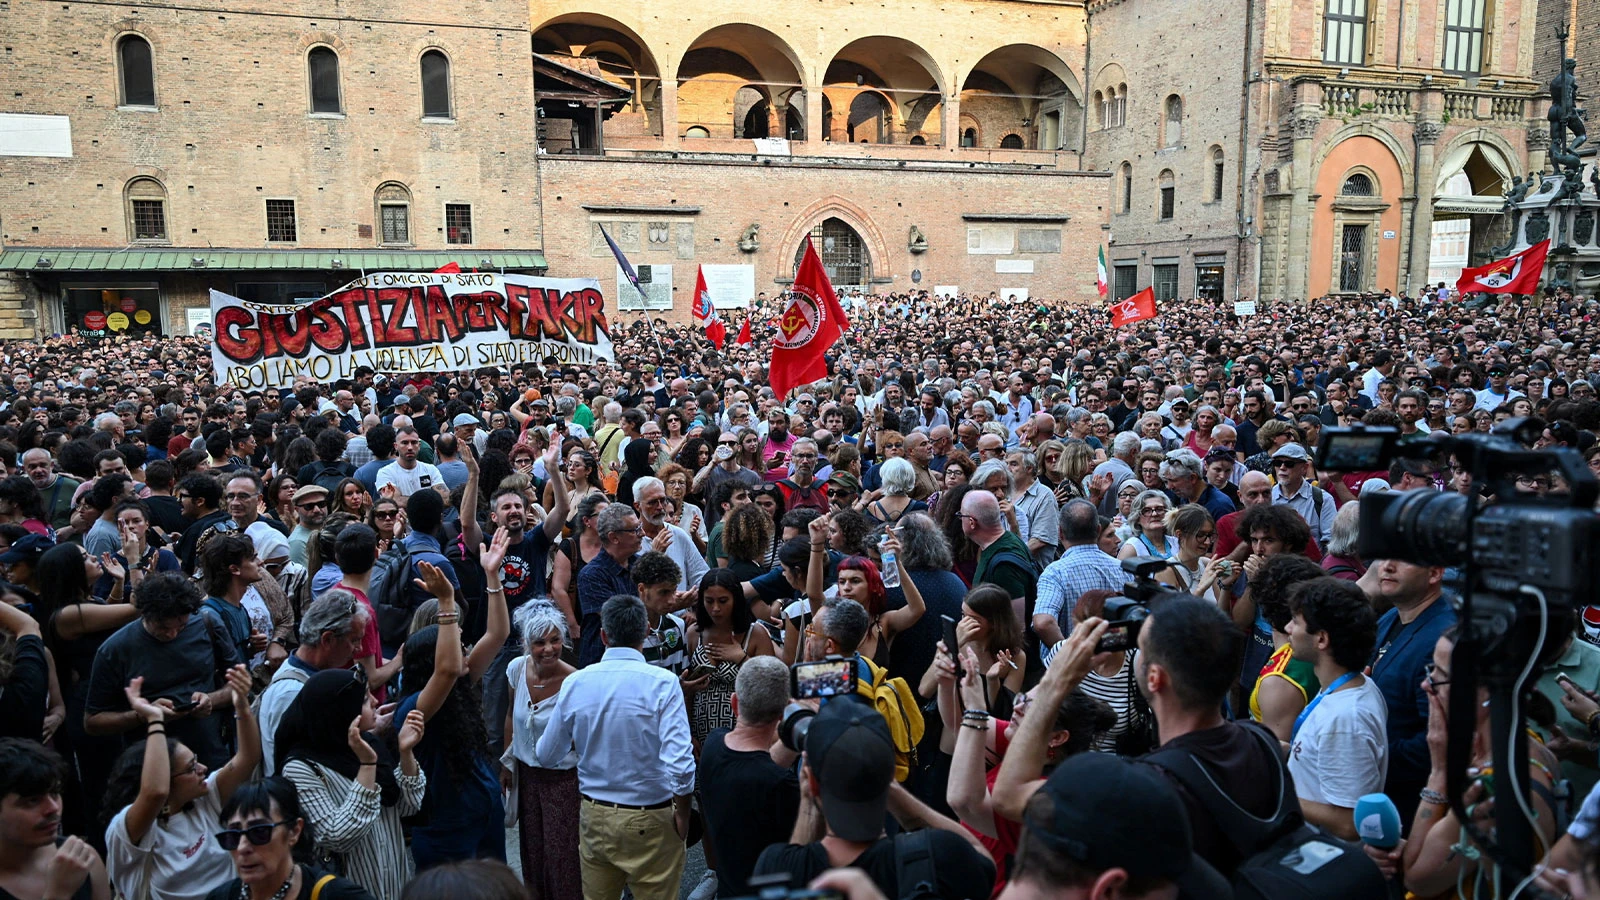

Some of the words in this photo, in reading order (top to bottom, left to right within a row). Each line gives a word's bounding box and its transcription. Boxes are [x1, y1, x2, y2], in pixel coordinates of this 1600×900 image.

[243, 302, 306, 314] CONTRO
[373, 275, 379, 286] E
[384, 274, 434, 286] OMICIDI
[441, 274, 452, 284] DI
[458, 273, 494, 286] STATO
[214, 284, 464, 366] GIUSTIZIA
[451, 290, 510, 333] PER
[504, 282, 612, 345] FAKIR
[226, 355, 334, 390] ABOLIAMO
[338, 355, 359, 378] LA
[366, 344, 449, 372] VIOLENZA
[454, 345, 472, 366] DI
[478, 341, 517, 364] STATO
